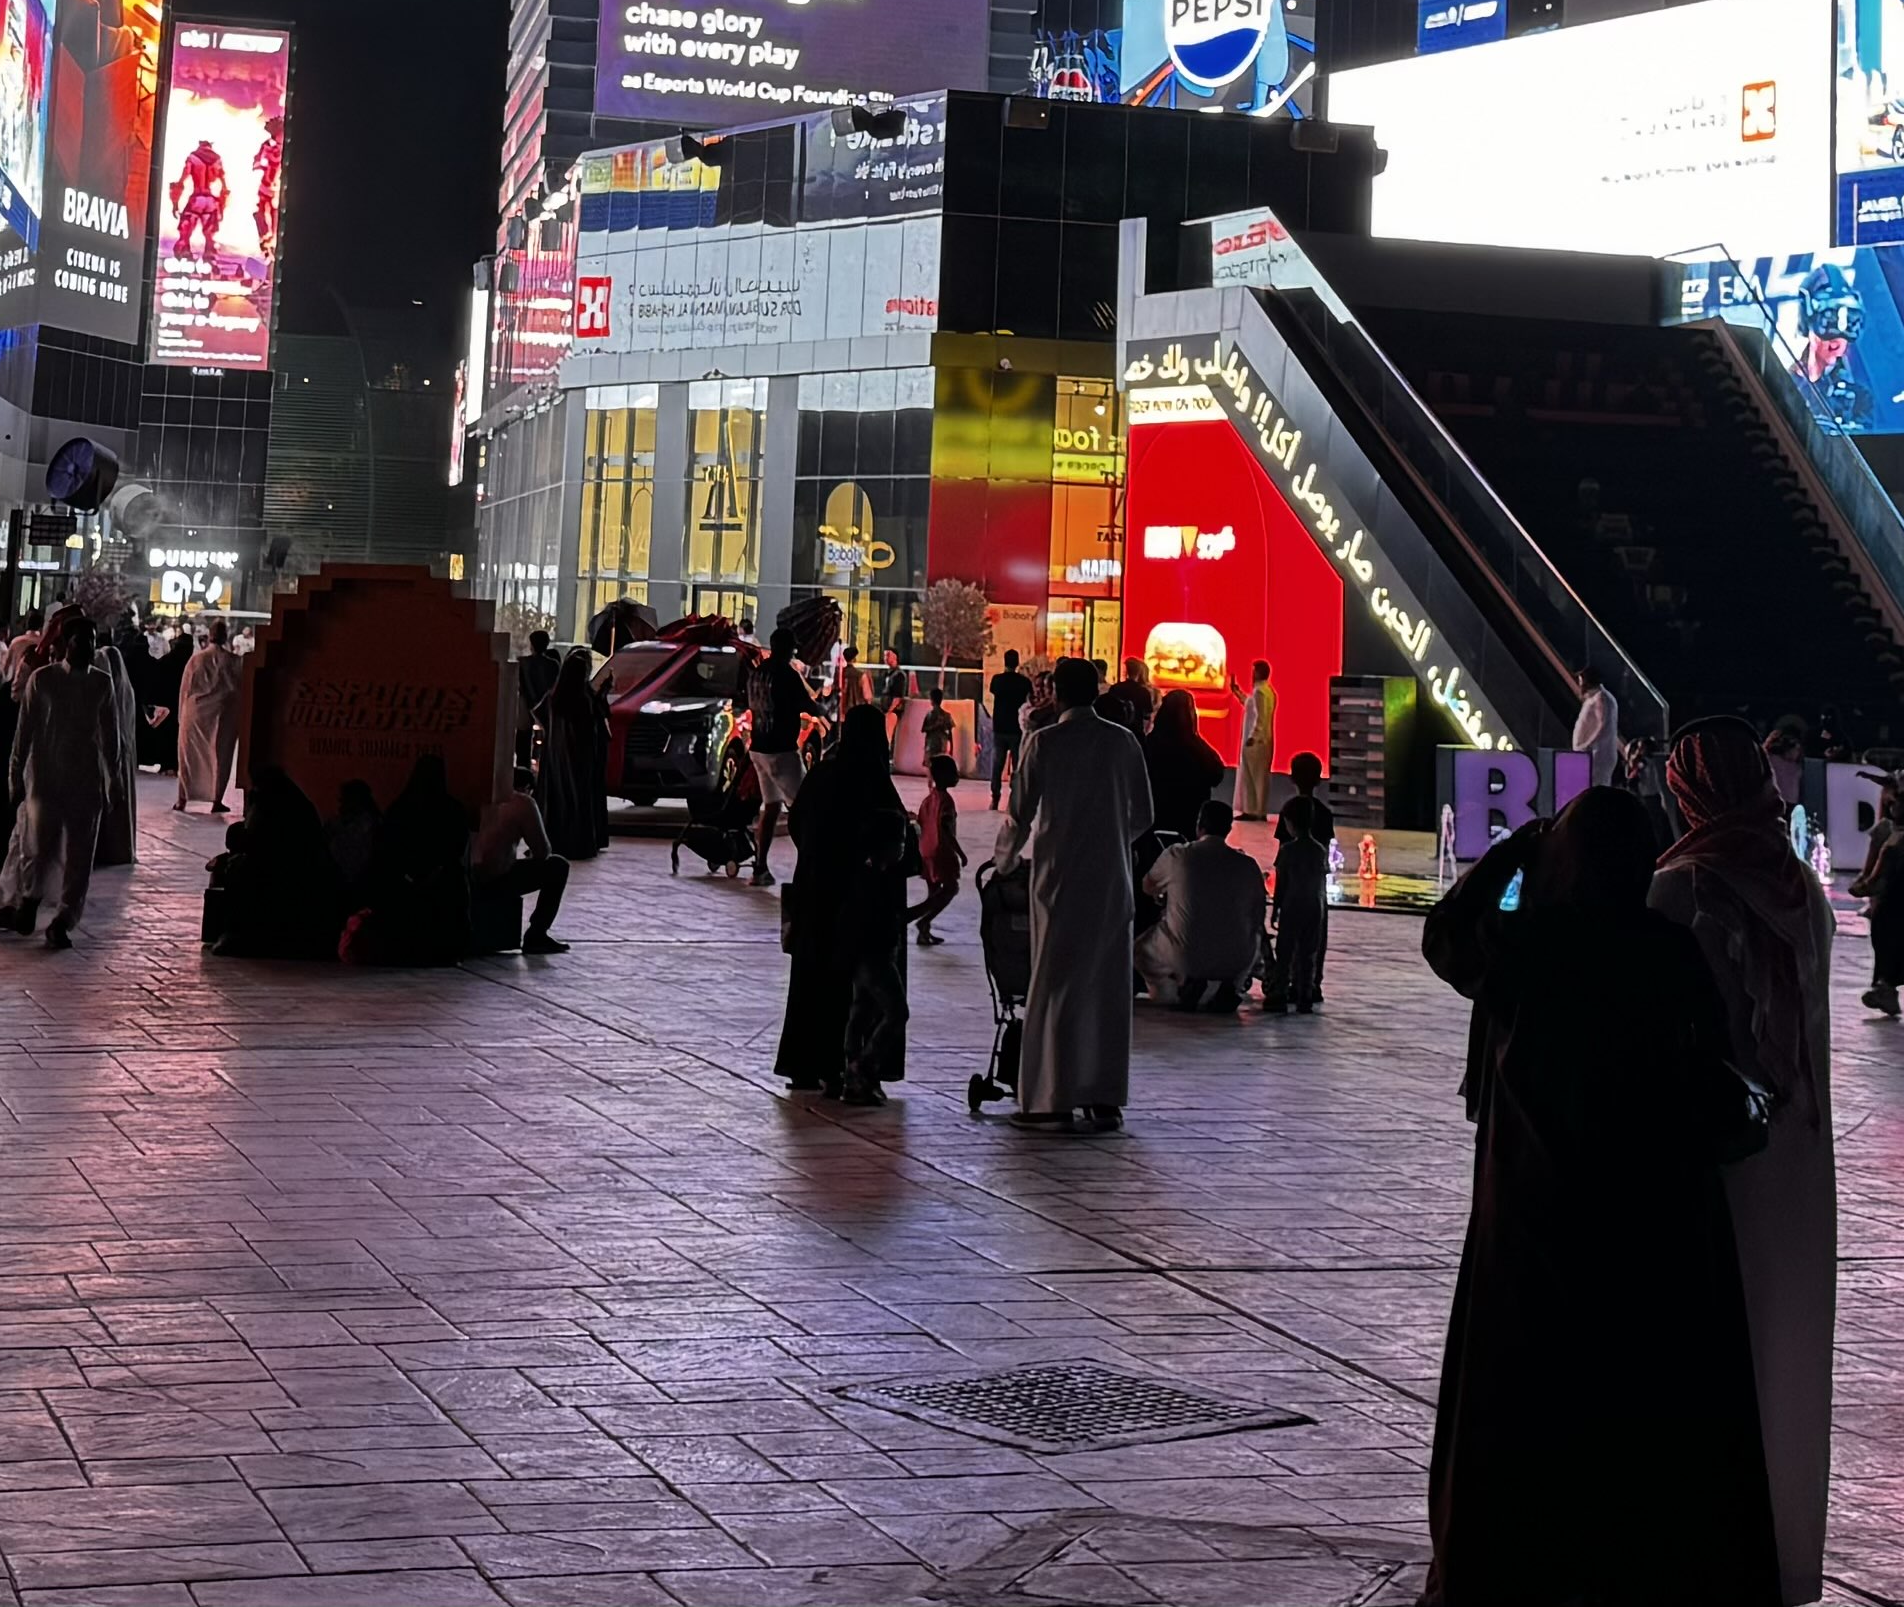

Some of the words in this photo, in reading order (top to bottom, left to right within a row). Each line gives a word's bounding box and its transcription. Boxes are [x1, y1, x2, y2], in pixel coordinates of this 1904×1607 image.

[625, 1, 697, 30] chase
[702, 8, 763, 38] glory
[624, 33, 676, 56] with
[681, 38, 745, 66] every
[749, 41, 800, 71] play
[622, 73, 641, 90] as
[643, 73, 704, 94] Esports
[707, 78, 756, 98] World
[758, 83, 791, 105] Cup
[63, 187, 129, 239] BRAVIA
[66, 248, 106, 274] CINEMA
[110, 259, 121, 278] IS
[54, 269, 96, 296] COMING
[99, 281, 128, 304] HOME
